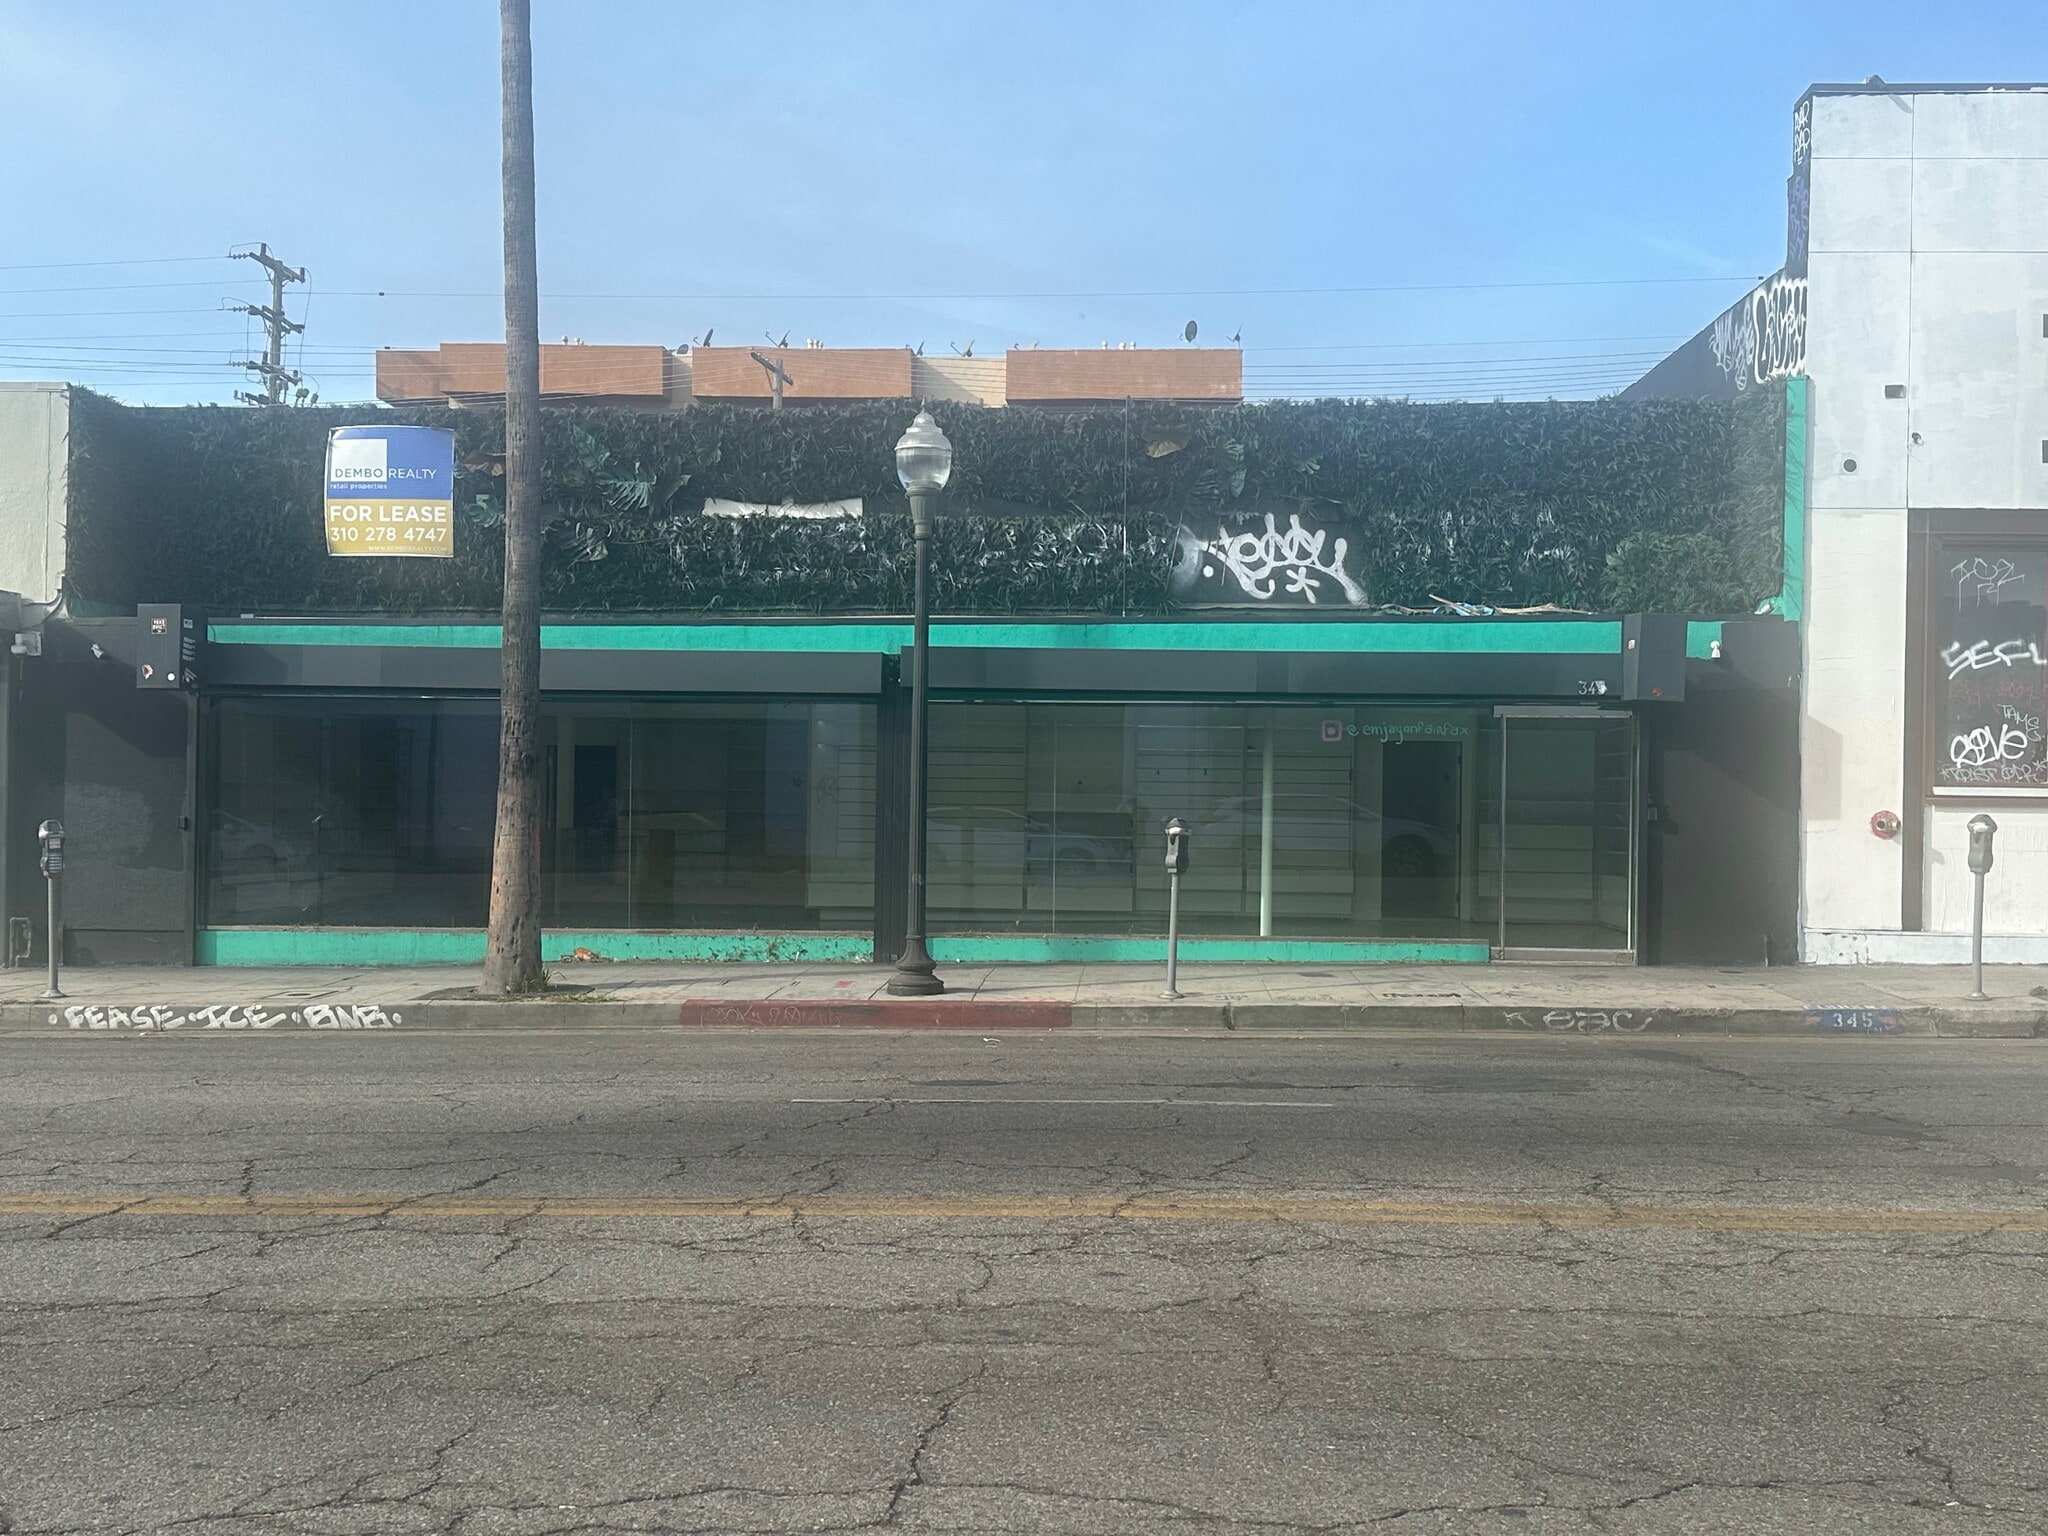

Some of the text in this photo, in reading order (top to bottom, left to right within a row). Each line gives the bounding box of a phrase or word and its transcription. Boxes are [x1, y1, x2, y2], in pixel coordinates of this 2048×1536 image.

[335, 468, 437, 479] DEMBO REALTY
[330, 505, 447, 523] FOR LEASE
[331, 527, 447, 542] 310 278 4747
[1832, 1012, 1873, 1028] 345
